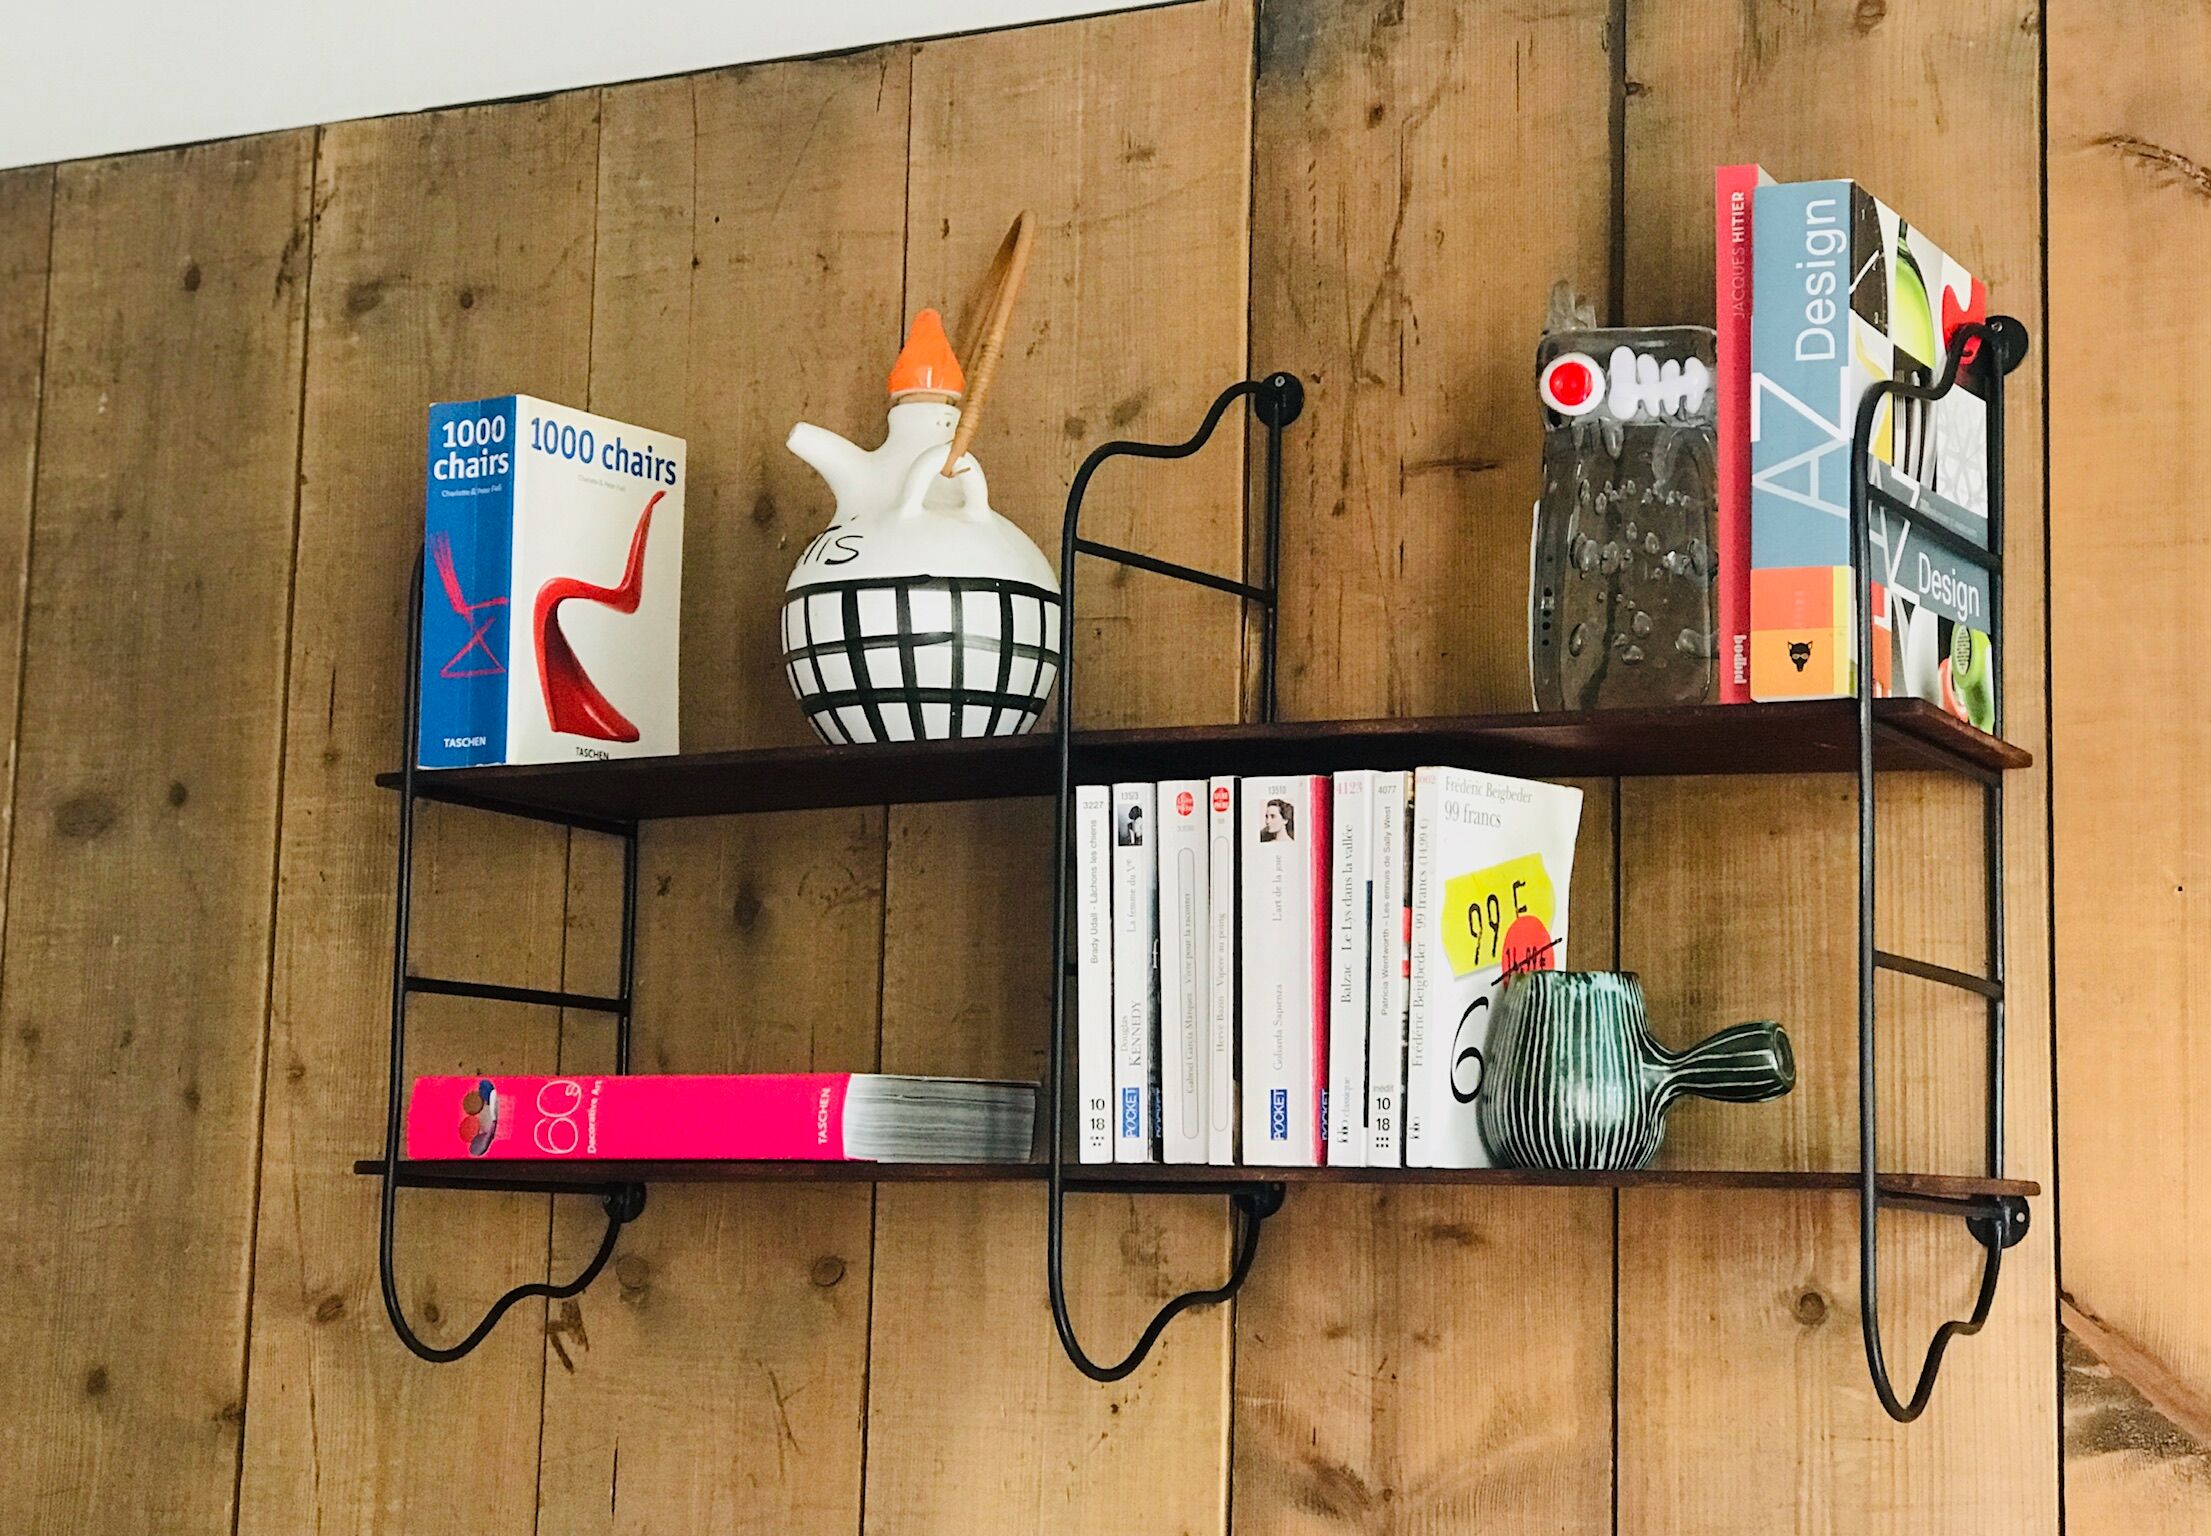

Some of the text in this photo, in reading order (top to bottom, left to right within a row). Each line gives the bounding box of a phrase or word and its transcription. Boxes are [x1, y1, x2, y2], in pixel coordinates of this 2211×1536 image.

[1731, 191, 1745, 318] JACQUES HITIER
[1795, 198, 1848, 361] Design
[442, 414, 506, 448] 1000
[433, 448, 509, 481] chairs
[531, 416, 677, 486] 1000 chairs
[1918, 551, 1980, 622] Design
[443, 736, 487, 749] TASCHEN
[575, 746, 609, 761] TASCHEN
[1336, 781, 1363, 795] 4123
[1377, 785, 1397, 795] 4077
[1485, 782, 1534, 805] Beigbeder
[1083, 801, 1104, 810] 3227
[1383, 805, 1393, 829] West
[1444, 800, 1502, 828] 99 francs
[1089, 819, 1098, 849] chiens
[1383, 831, 1394, 854] Sally
[1089, 850, 1098, 864] les
[1383, 855, 1391, 867] de
[1089, 866, 1098, 904] Lâchons
[1127, 874, 1137, 887] du
[1272, 874, 1282, 883] la
[1272, 886, 1282, 898] de
[1383, 869, 1392, 900] ennuis
[1415, 870, 1428, 910] francs
[1127, 888, 1137, 918] femme
[1340, 823, 1356, 1004] Balzac Le Lys dans la vallée
[1382, 903, 1391, 919] Les
[1090, 912, 1098, 936] Udall
[1127, 921, 1137, 933] La
[1217, 912, 1227, 940] poing
[1416, 913, 1426, 930] 99
[1468, 893, 1501, 966] 99
[1090, 937, 1100, 964] Brady
[1381, 928, 1391, 979] Wentworth
[1413, 941, 1428, 1008] Beigbeder
[1216, 995, 1225, 1021] Bazin
[1381, 980, 1390, 1017] Patricia
[1120, 1015, 1131, 1052] Douglas
[1129, 1000, 1142, 1067] KENNEDY
[1183, 1062, 1194, 1094] Gabriel
[817, 1087, 831, 1146] TASCHEN
[1090, 1097, 1106, 1111] 10
[1125, 1087, 1140, 1138] POCKET
[1273, 1089, 1286, 1141] POCKET
[1375, 1097, 1391, 1111] 10
[587, 1097, 599, 1154] Decorative
[1090, 1117, 1106, 1132] 18
[1375, 1117, 1391, 1132] 18
